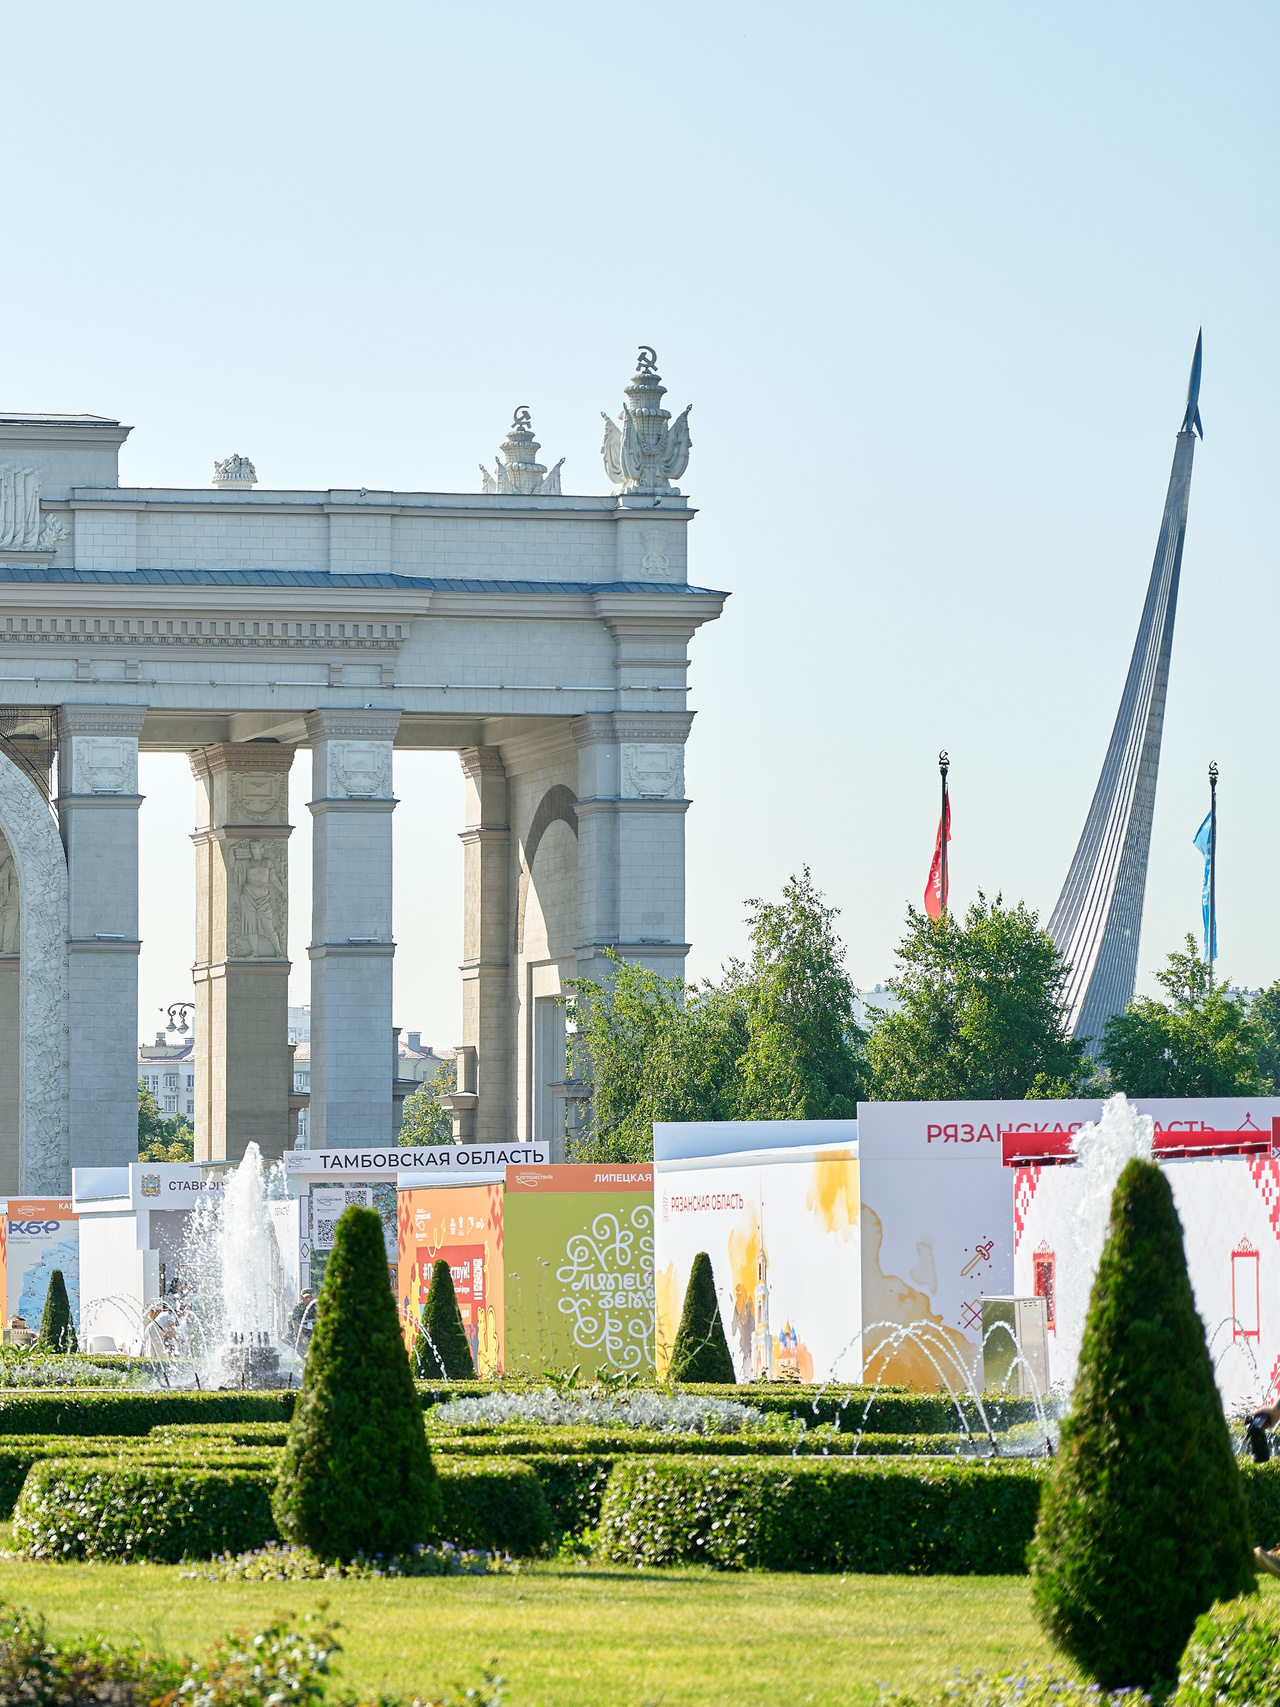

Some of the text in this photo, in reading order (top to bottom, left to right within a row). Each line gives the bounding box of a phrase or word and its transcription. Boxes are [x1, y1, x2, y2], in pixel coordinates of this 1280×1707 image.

[319, 1152, 450, 1169] ТАМБОВСКАЯ
[456, 1149, 544, 1165] ОБЛАСТЬ
[593, 1173, 652, 1184] ЛИПЕЦКАЯ
[671, 1193, 744, 1212] РЯЗАНСКАЯ ОБЛАСТЬ
